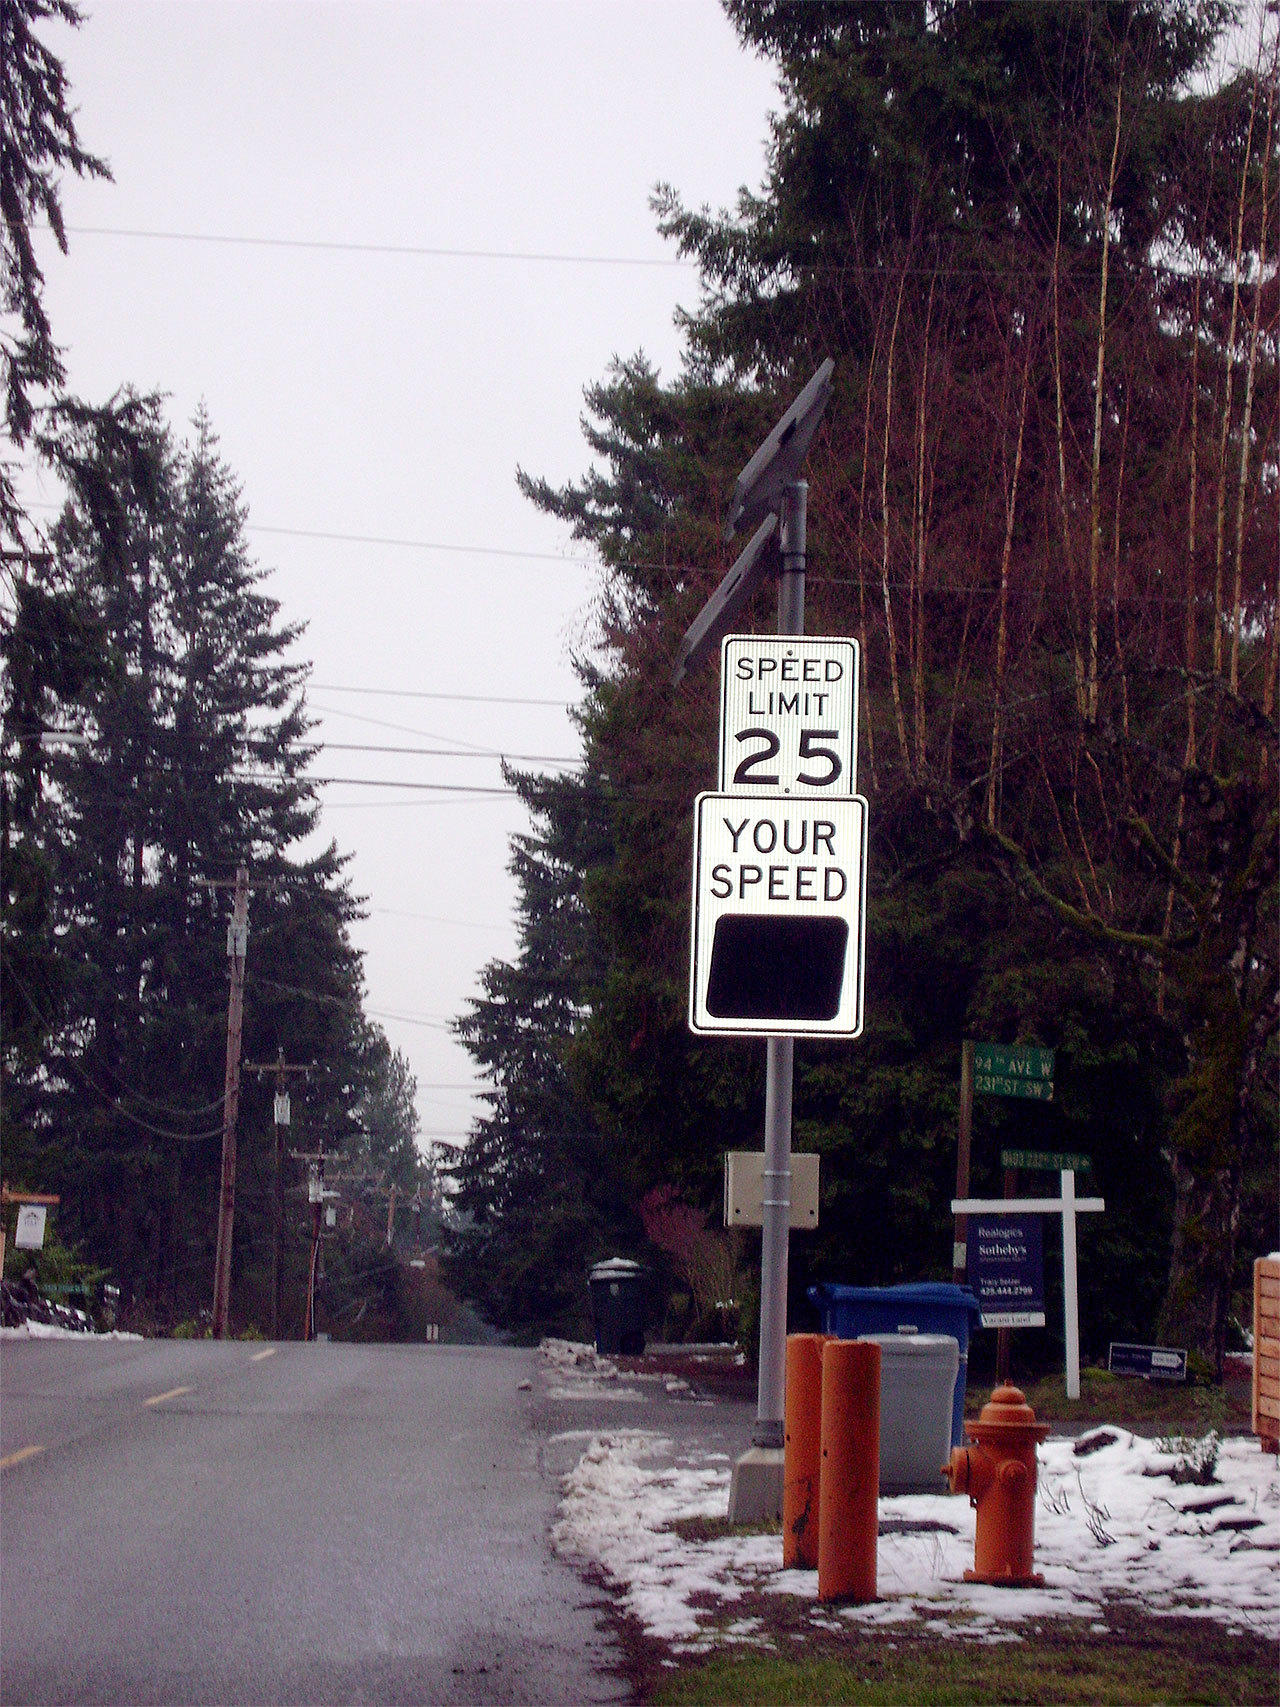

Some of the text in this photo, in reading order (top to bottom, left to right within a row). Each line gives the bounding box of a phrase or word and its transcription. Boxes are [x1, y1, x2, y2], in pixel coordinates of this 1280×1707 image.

[736, 657, 844, 682] SPEED
[749, 692, 829, 716] LIMIT
[733, 727, 843, 786] 25
[722, 817, 837, 856] YOUR
[710, 863, 848, 902] SPEED
[1009, 1060, 1032, 1075] AVE
[1041, 1061, 1052, 1077] W
[1003, 1079, 1018, 1095] ST
[1025, 1081, 1043, 1098] SW
[979, 1228, 1023, 1239] Realogics
